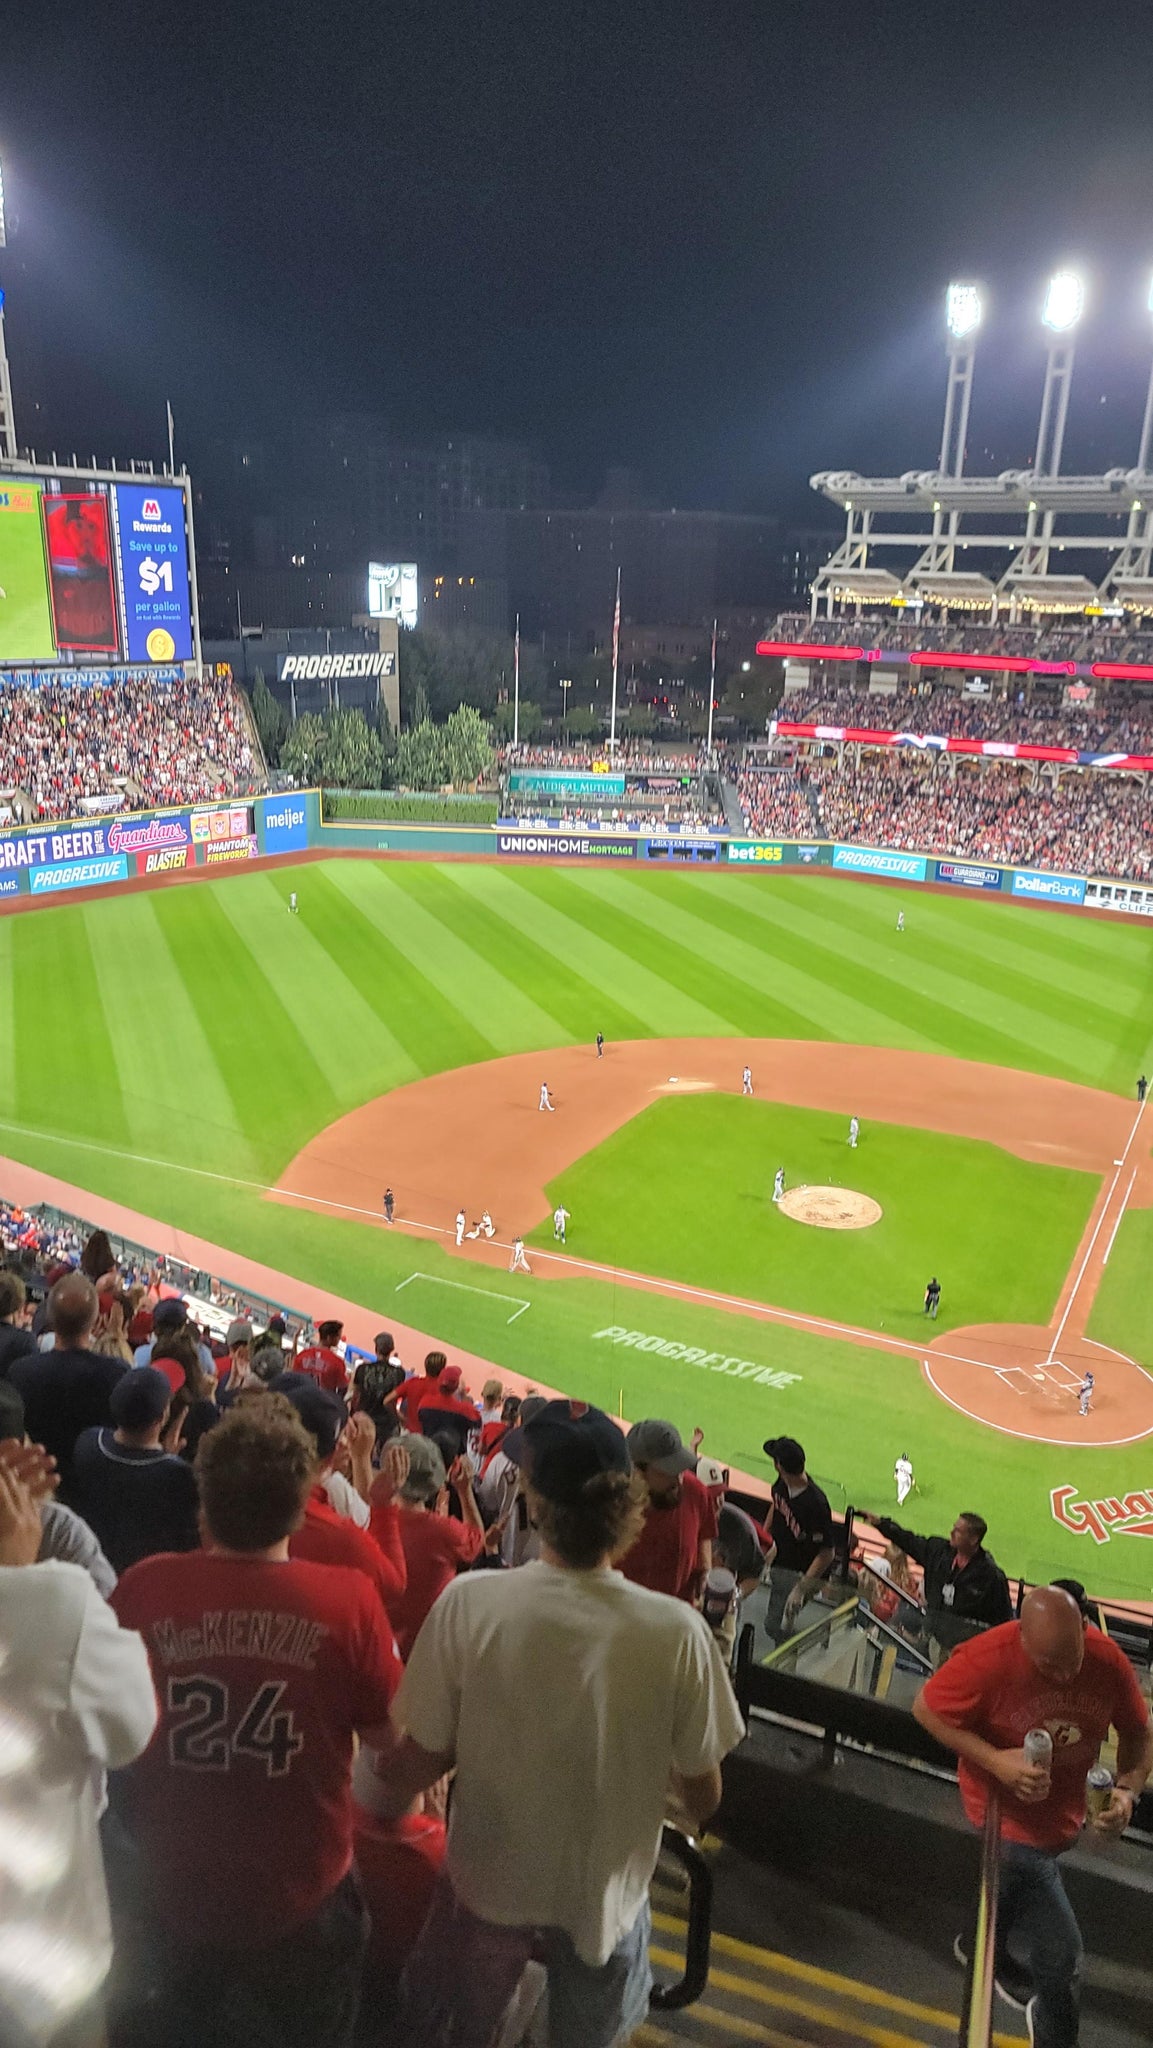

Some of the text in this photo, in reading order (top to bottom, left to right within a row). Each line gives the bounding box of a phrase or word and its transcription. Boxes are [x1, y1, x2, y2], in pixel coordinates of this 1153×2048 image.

[132, 520, 172, 533] Rewards
[130, 540, 178, 554] Save up to
[139, 556, 173, 596] $1
[136, 602, 181, 613] per gallon
[127, 668, 178, 680] HONDA
[281, 652, 395, 680] PROGRESSIVE
[578, 782, 618, 794] MUTUAL
[266, 808, 304, 829] meijer
[94, 830, 104, 842] OF
[108, 820, 187, 854] Guardians
[651, 839, 685, 848] LECOM
[0, 832, 93, 868] CRAFT BEER
[95, 843, 104, 854] THE
[207, 838, 249, 853] PHANTOM
[590, 845, 633, 856] MORTGAGE
[728, 844, 782, 860] bet365
[146, 849, 188, 872] BLASTER
[207, 849, 249, 863] FIREWORKS
[836, 850, 920, 874] PROGRESSIVE
[33, 861, 122, 888] PROGRESSIVE
[592, 1326, 803, 1388] PROGRESSIVE
[153, 1609, 330, 1671] McKENZIE
[168, 1673, 304, 1778] 24
